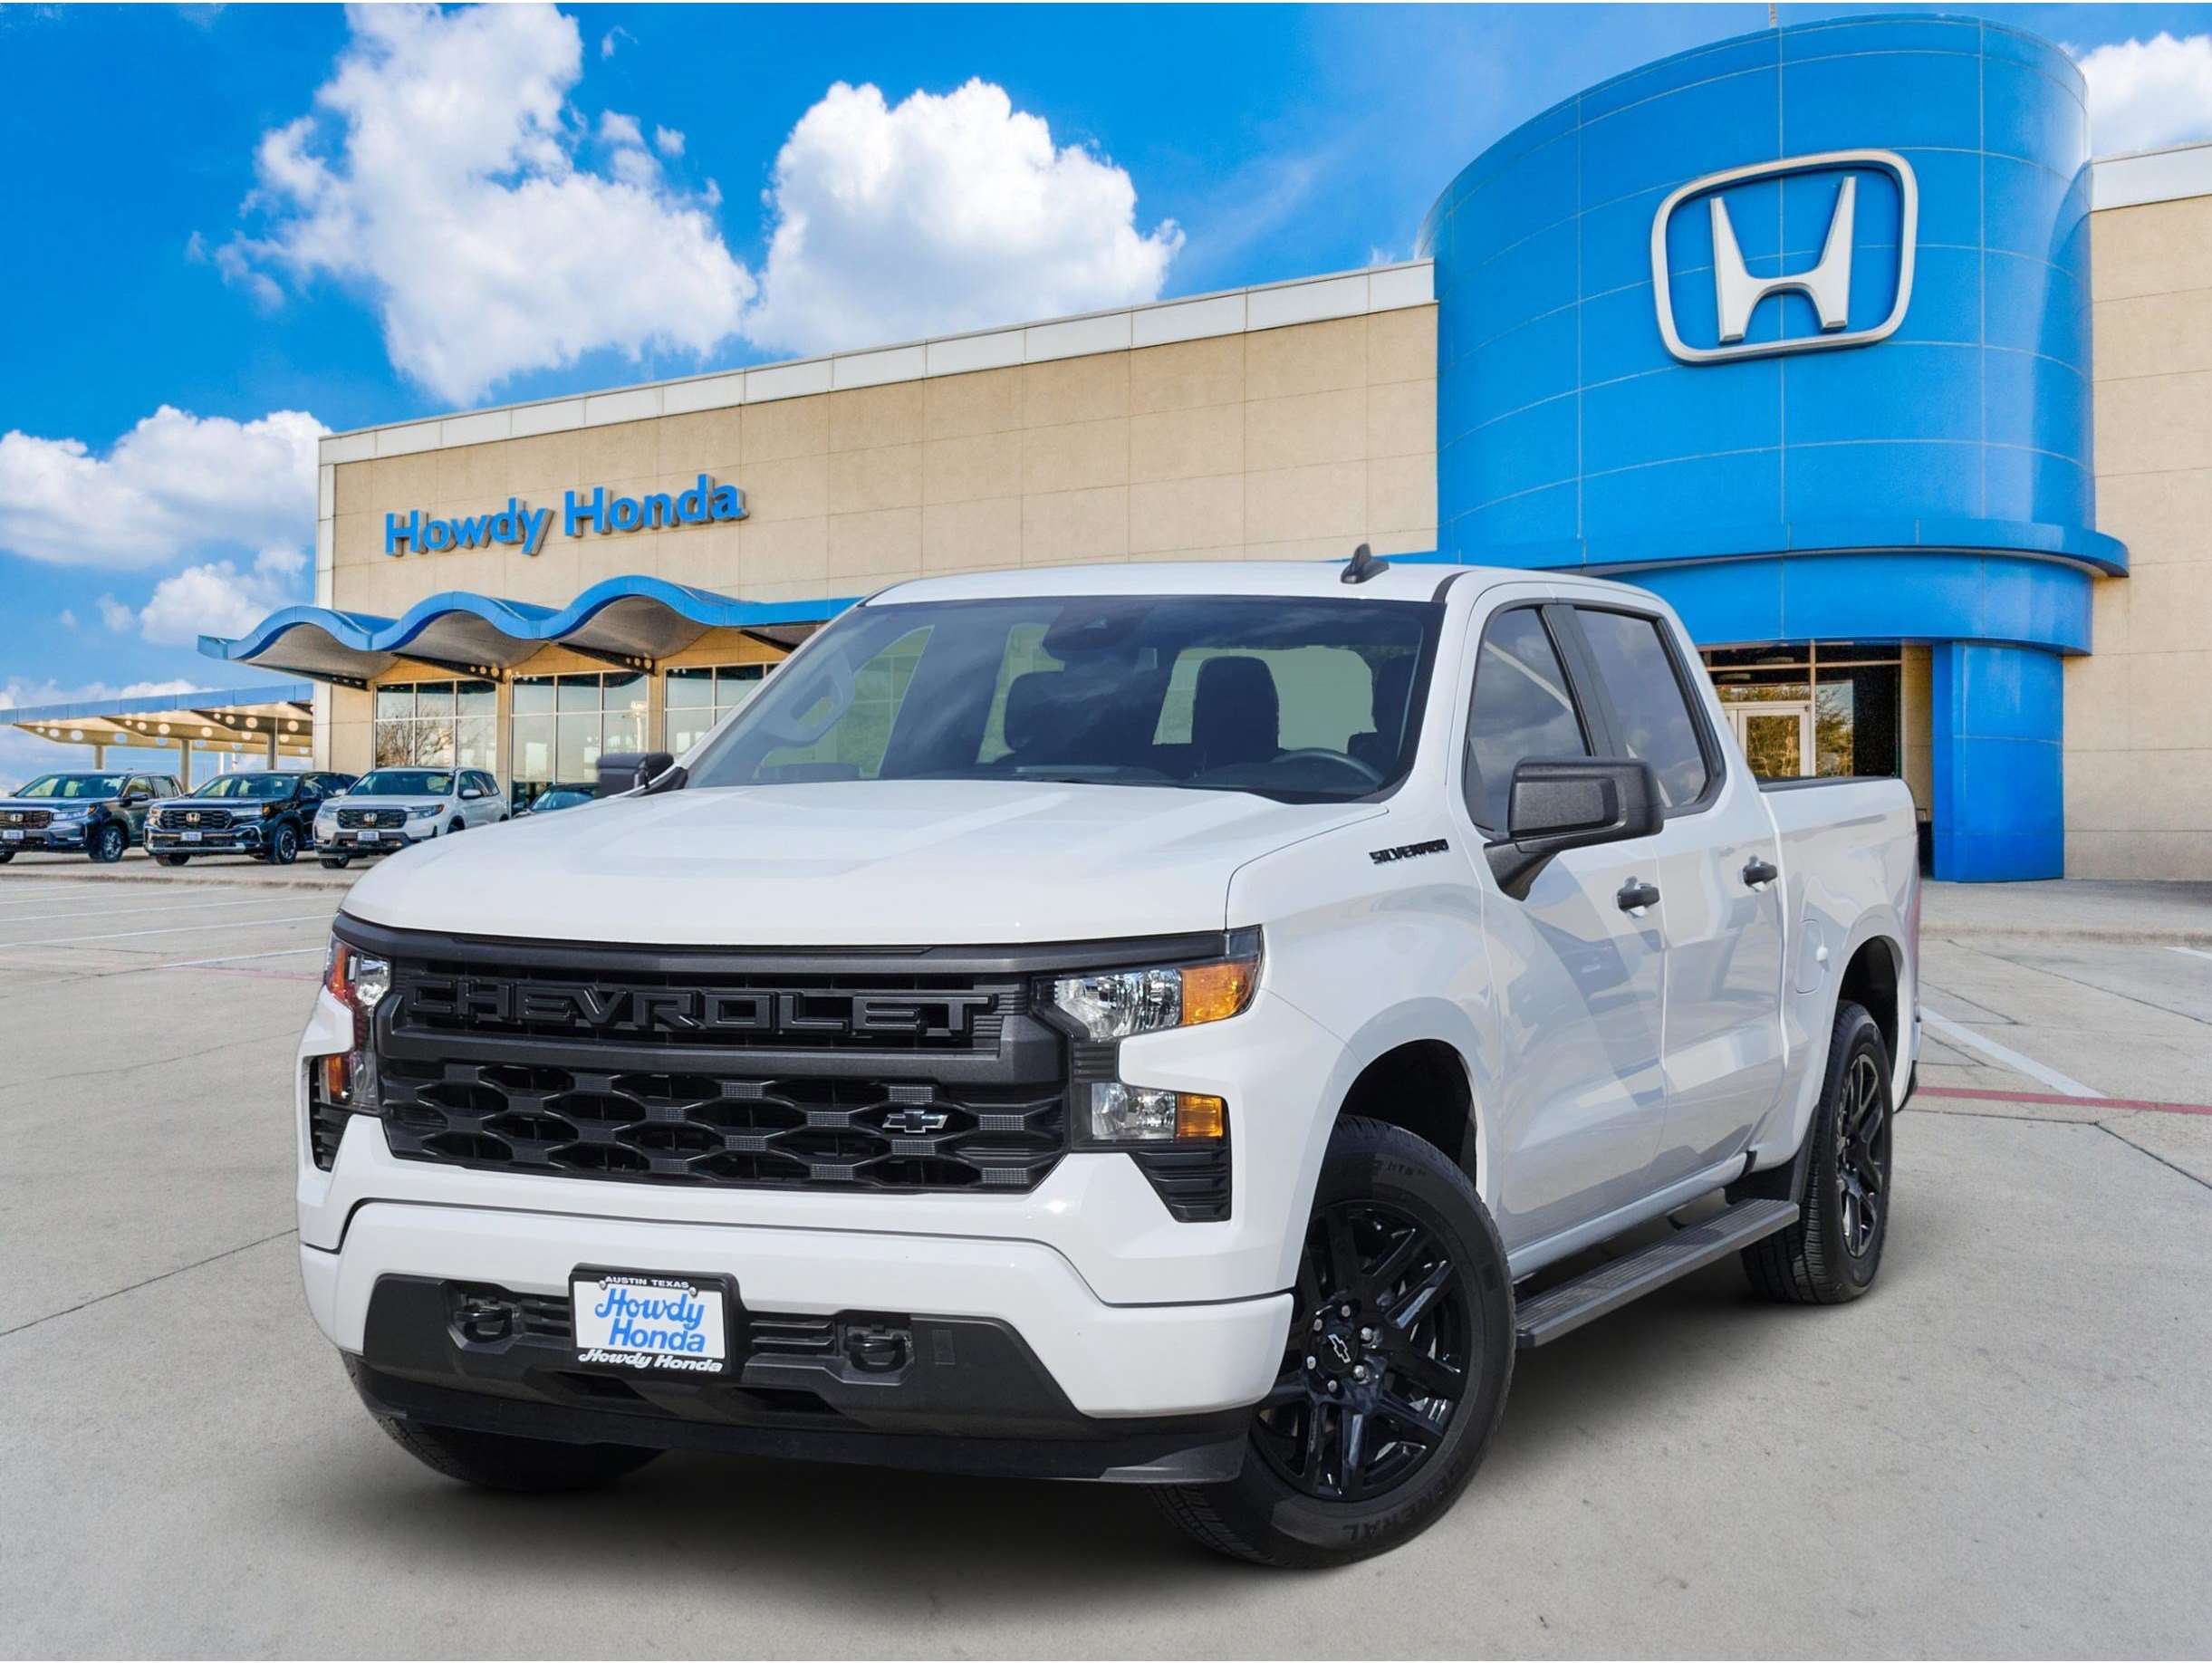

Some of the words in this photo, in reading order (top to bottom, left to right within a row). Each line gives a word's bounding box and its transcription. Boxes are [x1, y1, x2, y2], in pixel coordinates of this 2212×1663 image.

[385, 496, 555, 556] Howdy
[564, 473, 749, 537] Honda
[405, 978, 996, 1034] CHEVROLET
[604, 1275, 647, 1285] AUSTIN
[651, 1279, 689, 1289] TEXAS
[594, 1288, 705, 1331] Howdy
[609, 1319, 706, 1352] Honda
[578, 1349, 652, 1369] Howdy
[654, 1355, 723, 1372] Honda
